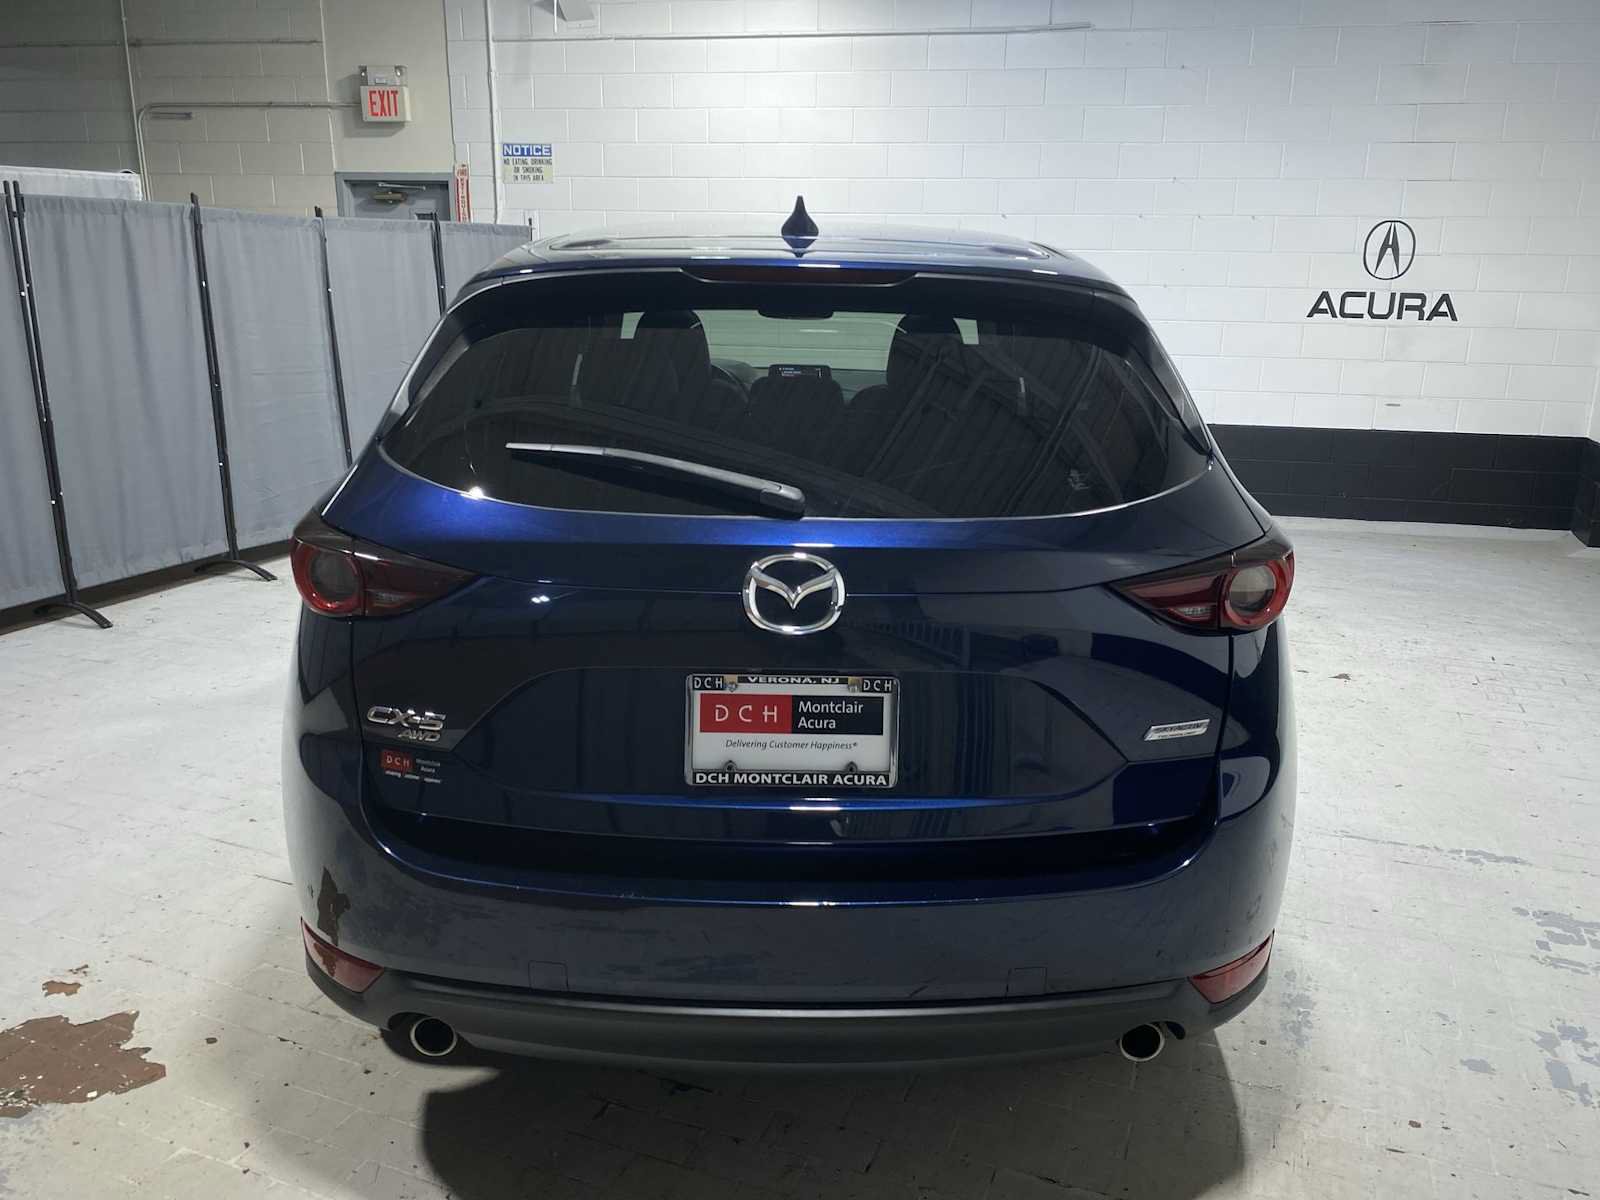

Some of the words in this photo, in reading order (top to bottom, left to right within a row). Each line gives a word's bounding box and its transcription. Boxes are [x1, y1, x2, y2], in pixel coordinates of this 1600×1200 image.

[369, 90, 398, 117] EXIT
[503, 144, 551, 156] NOTICE
[522, 166, 543, 174] SMOKING
[533, 174, 544, 182] AREA
[1306, 291, 1458, 322] ACURA
[798, 700, 864, 714] Montclair
[798, 716, 836, 729] Acura
[398, 729, 441, 742] AWD
[725, 739, 767, 751] Delivering
[769, 740, 809, 749] Customer
[695, 773, 729, 784] DCH
[733, 773, 828, 785] MONTCLAIR
[832, 774, 887, 786] ACURA
